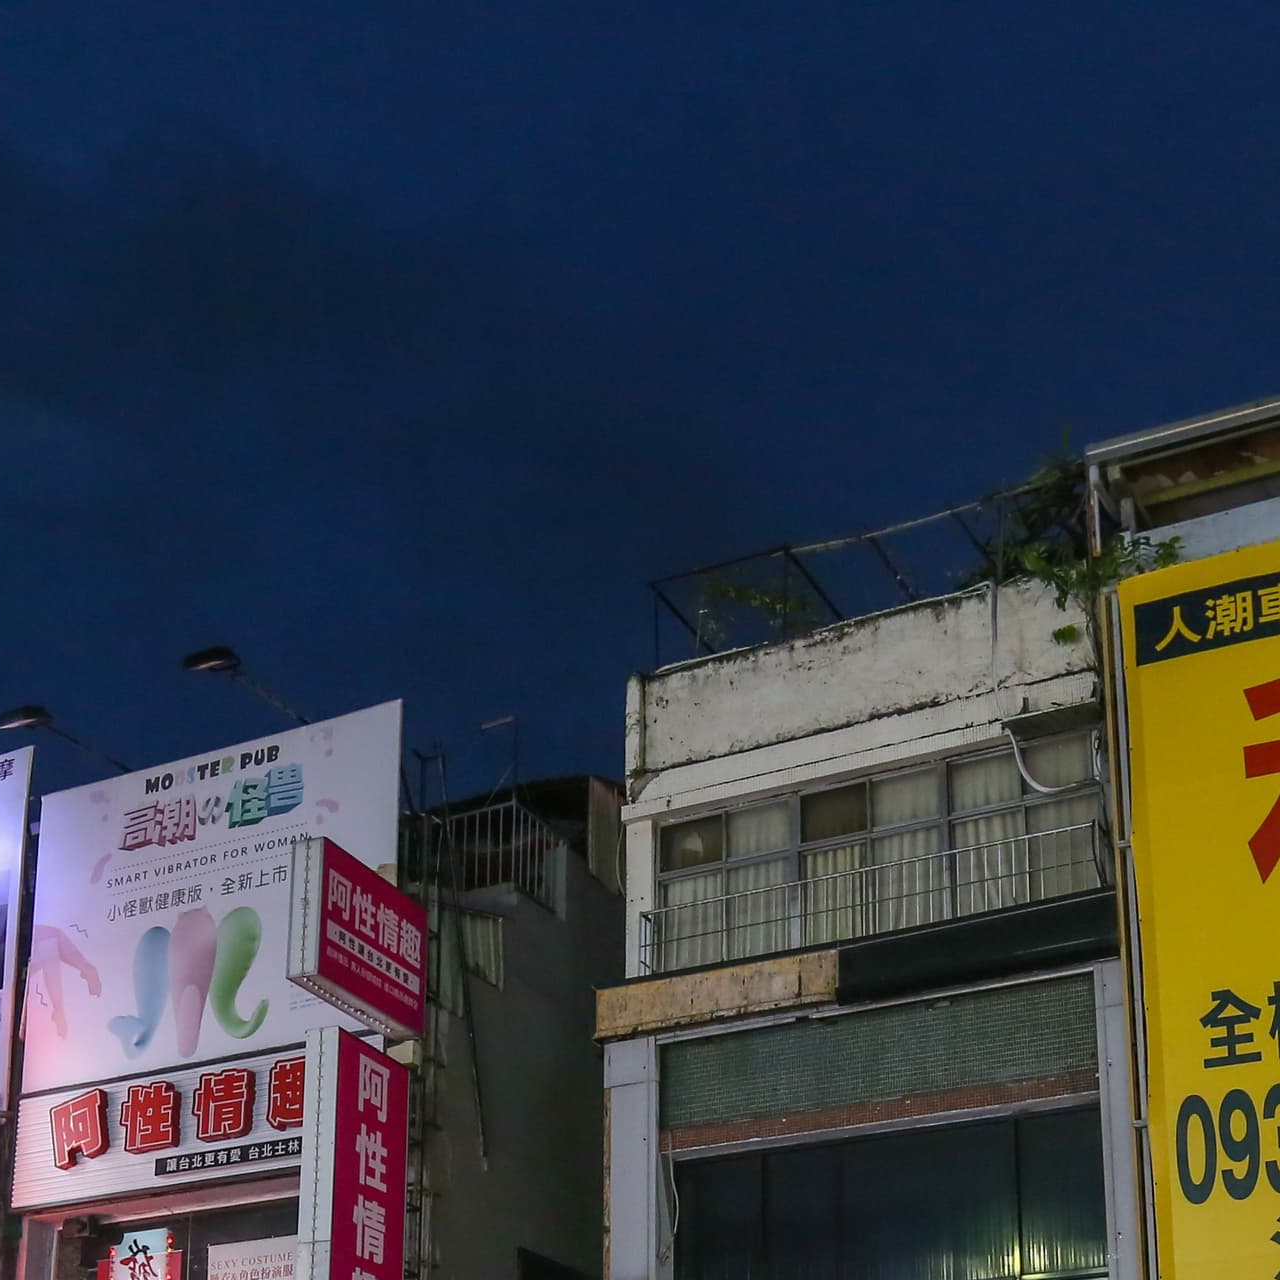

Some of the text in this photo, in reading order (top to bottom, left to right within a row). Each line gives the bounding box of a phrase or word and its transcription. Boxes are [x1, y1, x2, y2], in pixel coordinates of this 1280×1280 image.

[145, 745, 280, 796] MONSTER PUB
[107, 832, 310, 889] SMART VIBRATOR FOR WOMAN
[328, 867, 422, 969] 阿性情趣
[49, 1056, 307, 1171] 阿性情趣
[167, 1138, 301, 1172] 讓台北更有愛 台北士林
[242, 1251, 293, 1266] COSTUME
